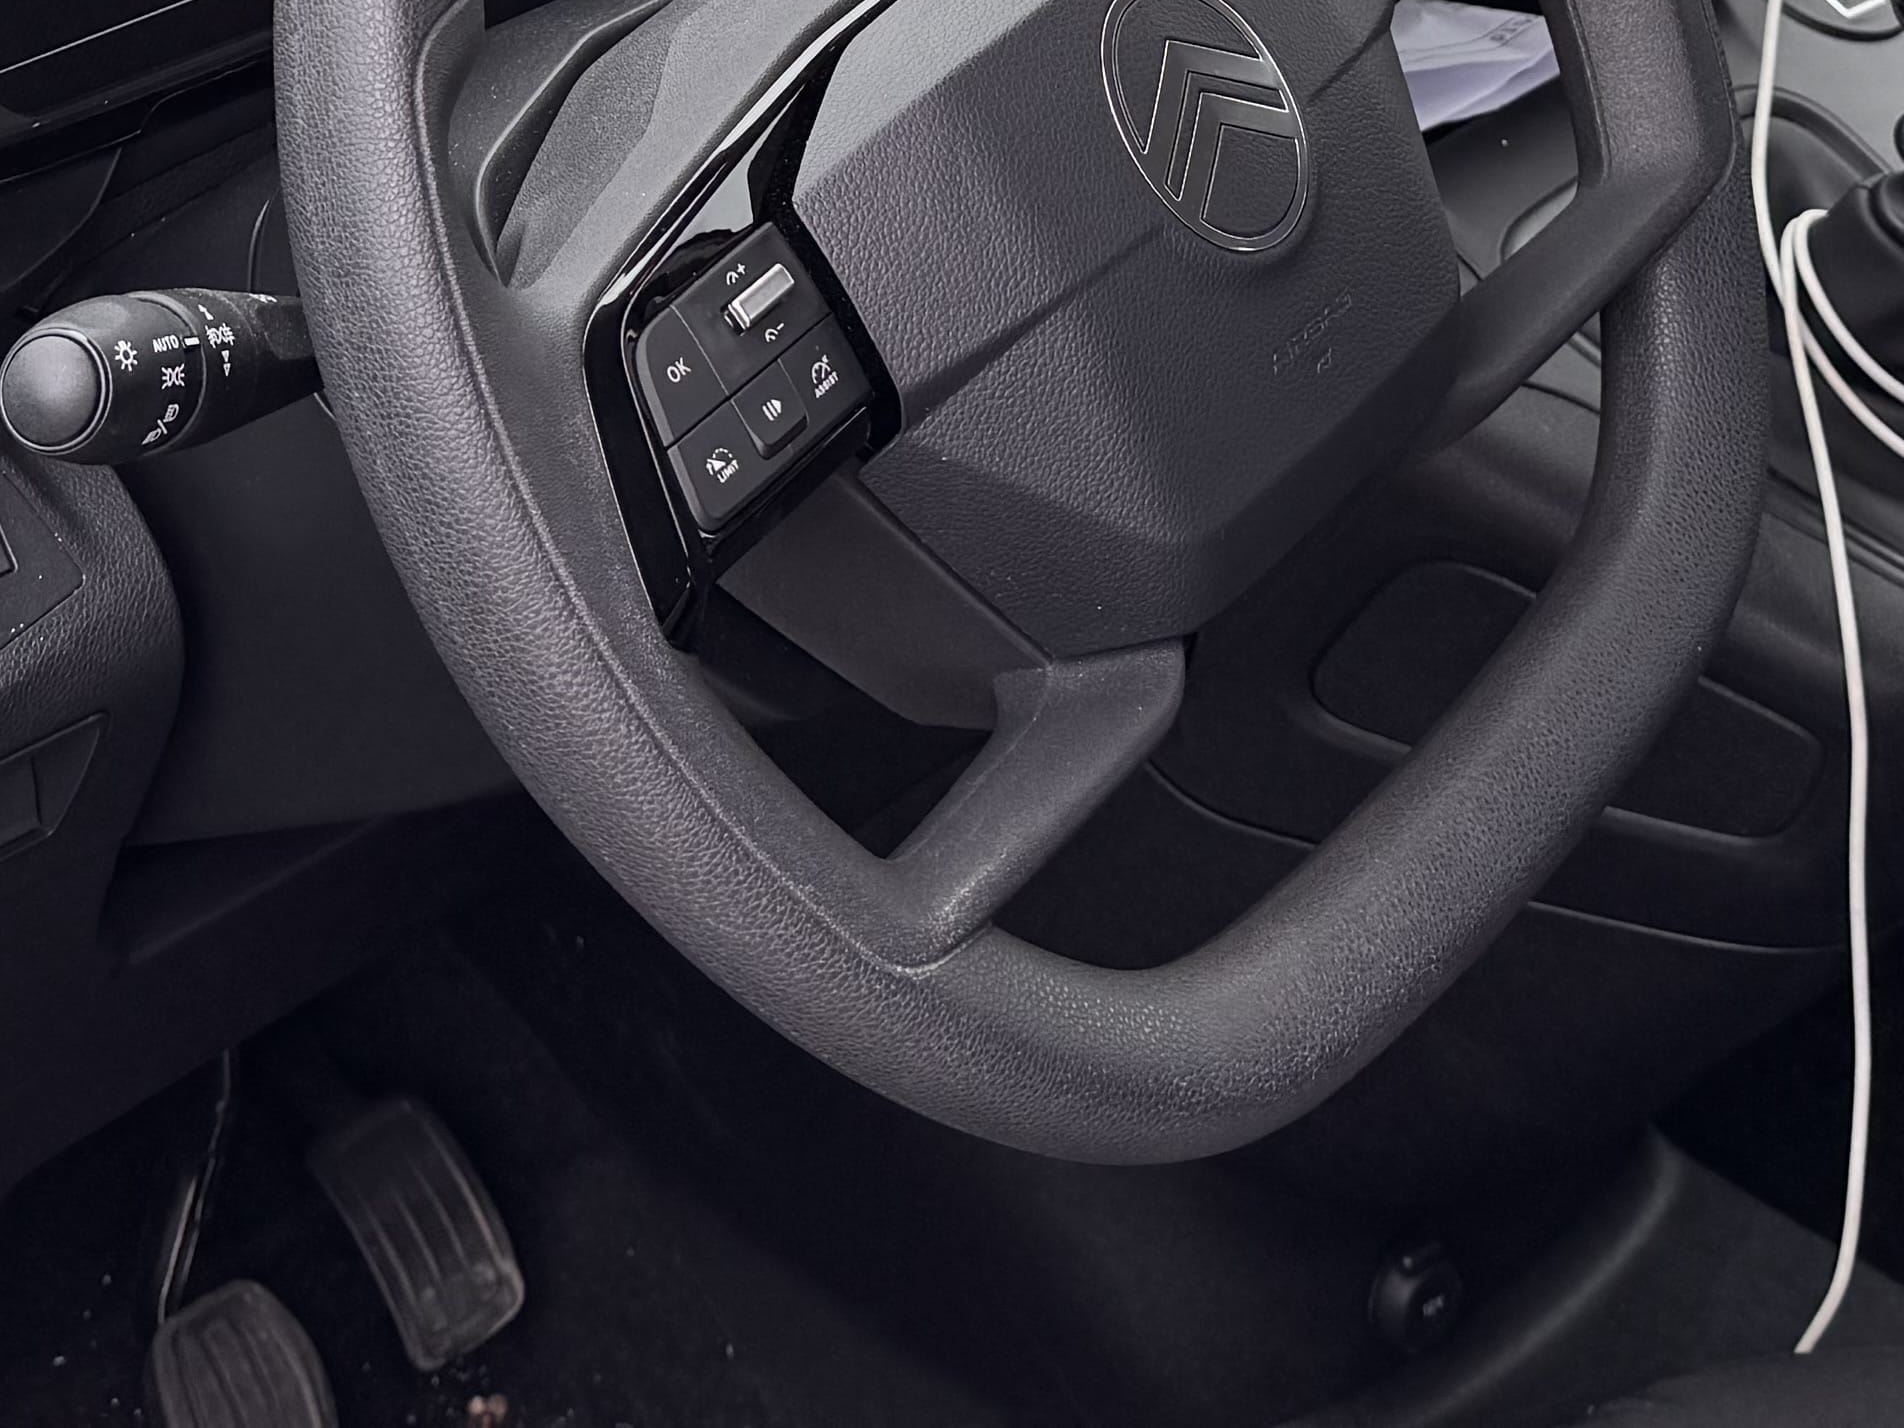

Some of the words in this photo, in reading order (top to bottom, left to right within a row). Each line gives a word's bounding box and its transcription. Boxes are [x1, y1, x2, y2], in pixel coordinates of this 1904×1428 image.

[152, 334, 180, 353] AUTO
[666, 357, 692, 383] OK
[814, 371, 839, 399] ASSIST
[717, 459, 740, 484] LIMIT
